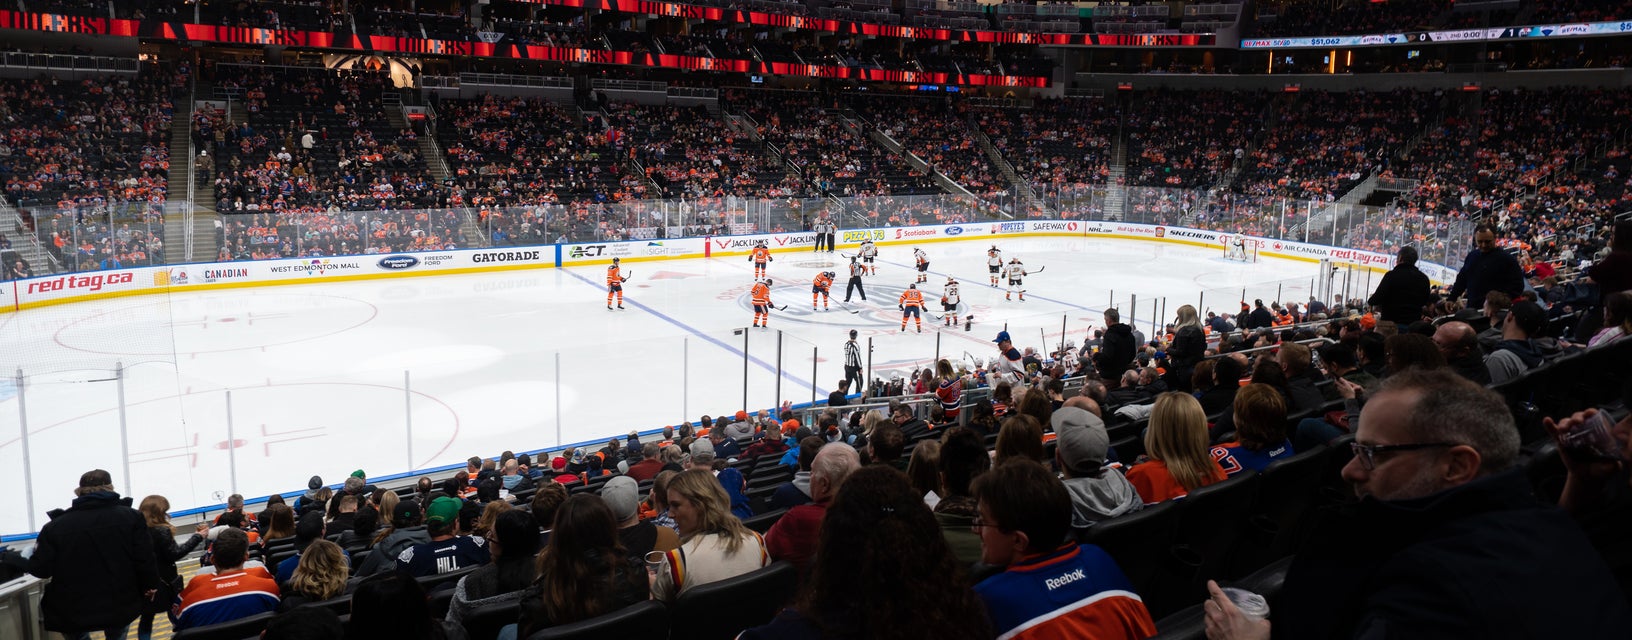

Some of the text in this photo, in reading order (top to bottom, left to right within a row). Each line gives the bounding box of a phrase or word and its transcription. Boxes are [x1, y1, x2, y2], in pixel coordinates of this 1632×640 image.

[1419, 33, 1426, 41] 0
[1509, 29, 1514, 37] 1
[1311, 38, 1341, 46] $51,062
[873, 230, 885, 240] 73
[904, 228, 937, 237] Scotiabank
[1170, 230, 1216, 241] SKECHERS
[731, 239, 749, 248] JACK
[788, 236, 805, 244] JACK
[571, 245, 606, 259] ACT
[1296, 247, 1327, 256] CANADA
[472, 251, 540, 263] GATORADE
[294, 263, 339, 272] EDMONTON
[205, 268, 248, 279] CANADIAN
[436, 555, 461, 575] HILL
[1045, 568, 1086, 591] Reebok
